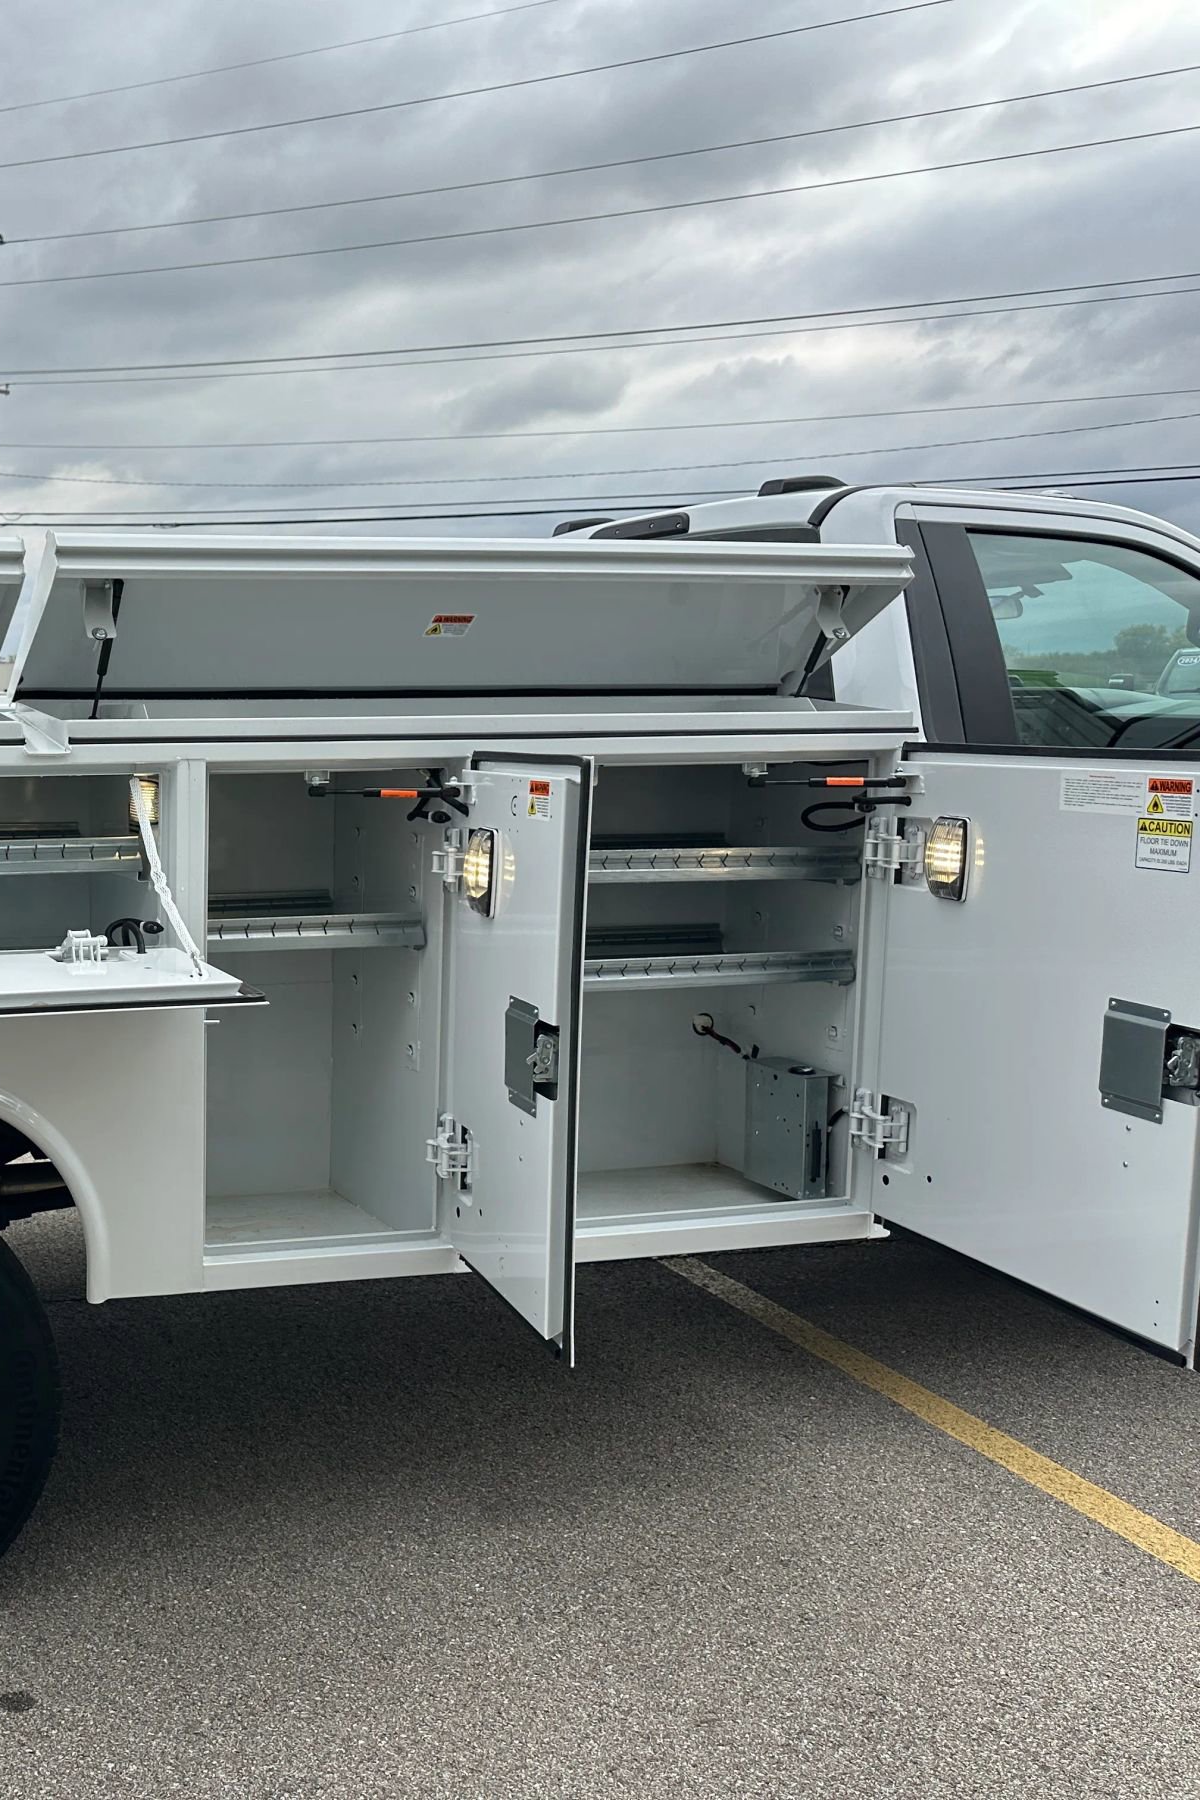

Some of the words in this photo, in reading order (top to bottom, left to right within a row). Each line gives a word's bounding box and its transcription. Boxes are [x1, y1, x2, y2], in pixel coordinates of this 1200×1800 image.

[1158, 780, 1192, 793] WARNING
[1148, 821, 1191, 835] CAUTION
[1139, 837, 1159, 845] FLOOR
[1170, 839, 1189, 848] DOWN
[1149, 847, 1177, 857] MAXIMUM
